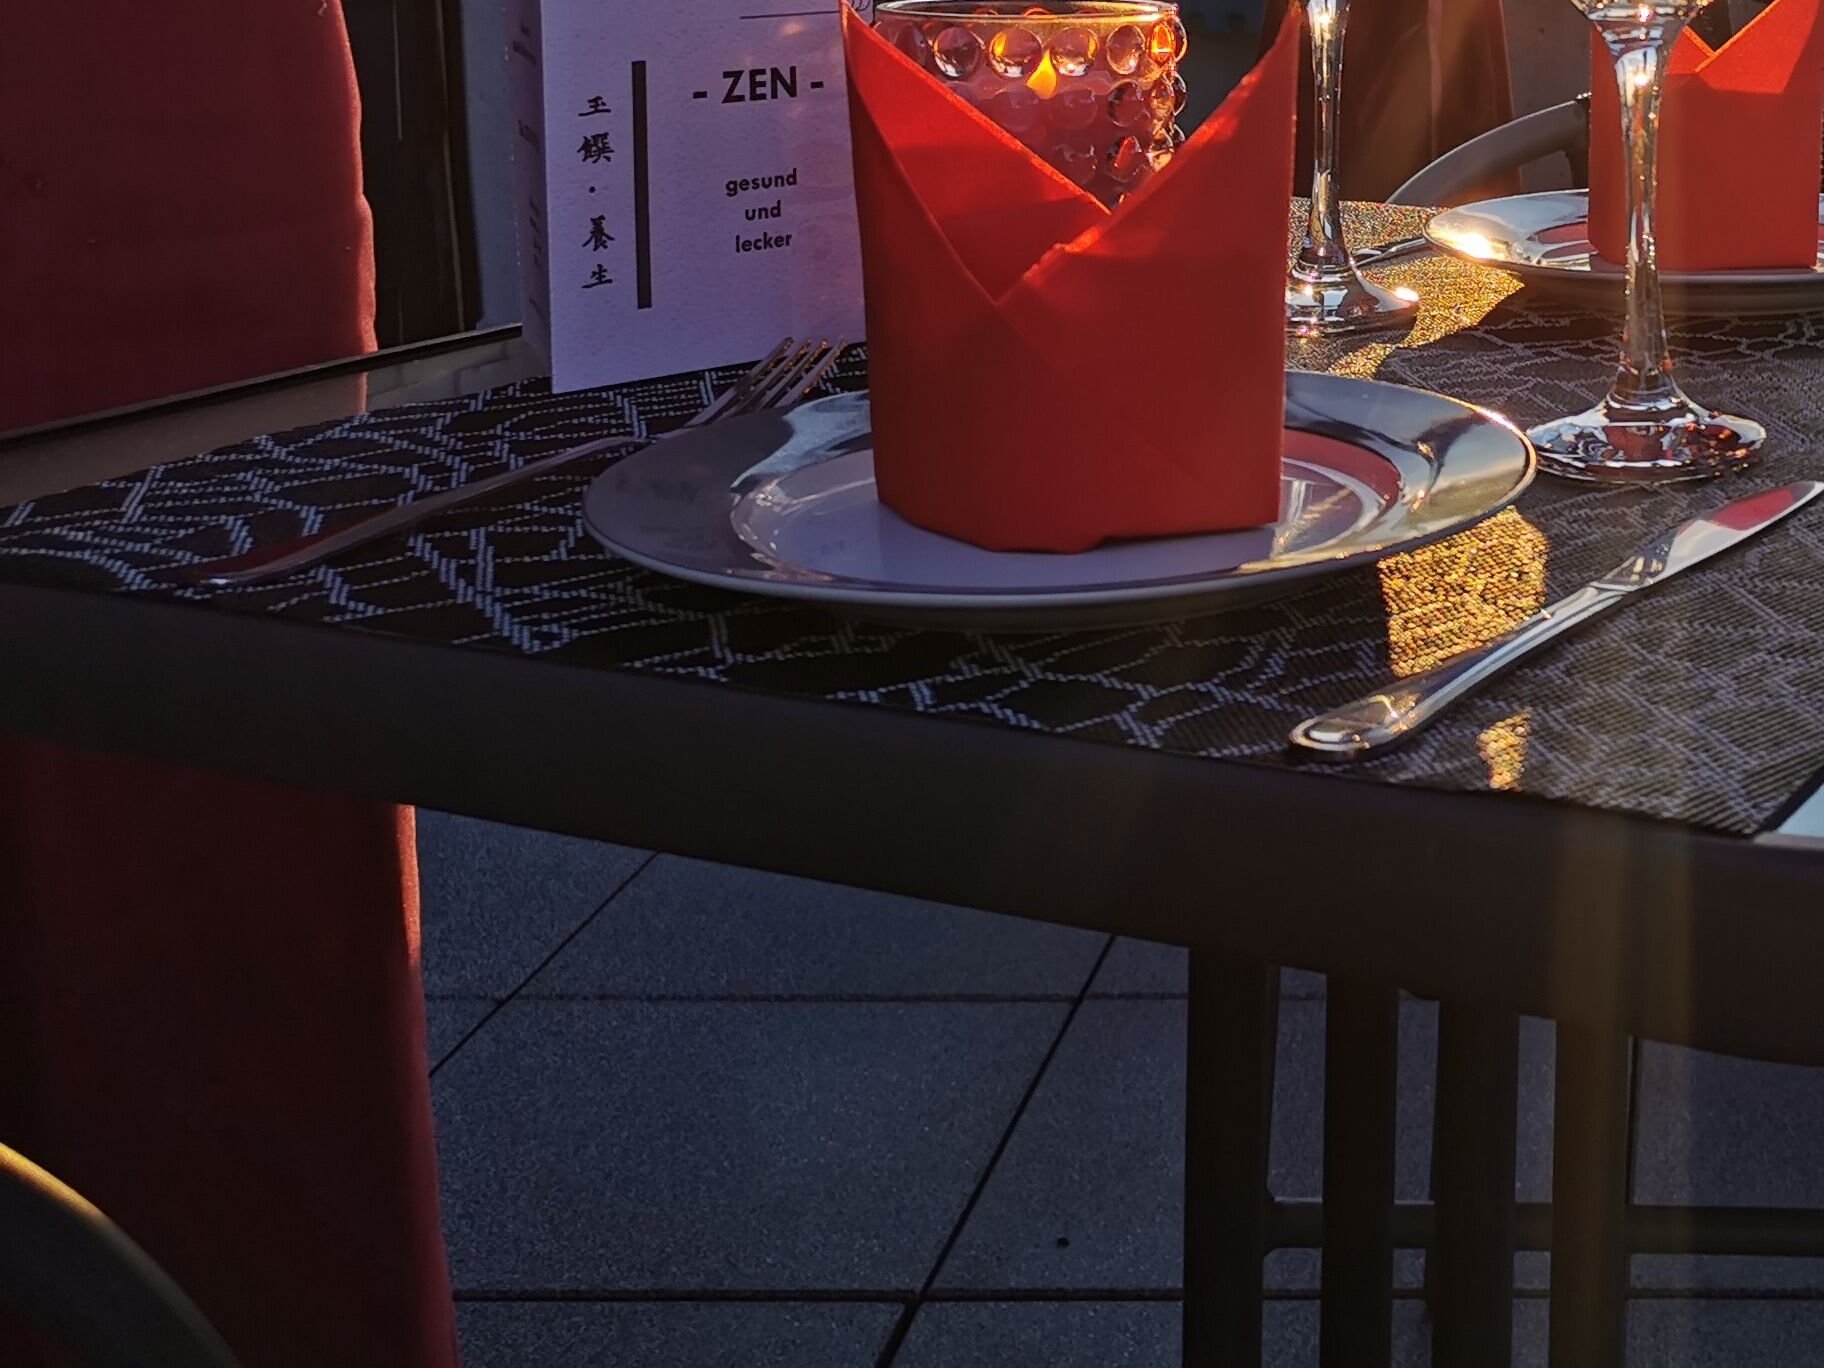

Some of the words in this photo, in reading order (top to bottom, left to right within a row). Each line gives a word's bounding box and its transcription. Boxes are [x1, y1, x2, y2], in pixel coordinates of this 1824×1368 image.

[721, 65, 798, 105] ZEN
[725, 168, 798, 197] gesund
[744, 199, 782, 222] und
[735, 232, 793, 254] lecker
